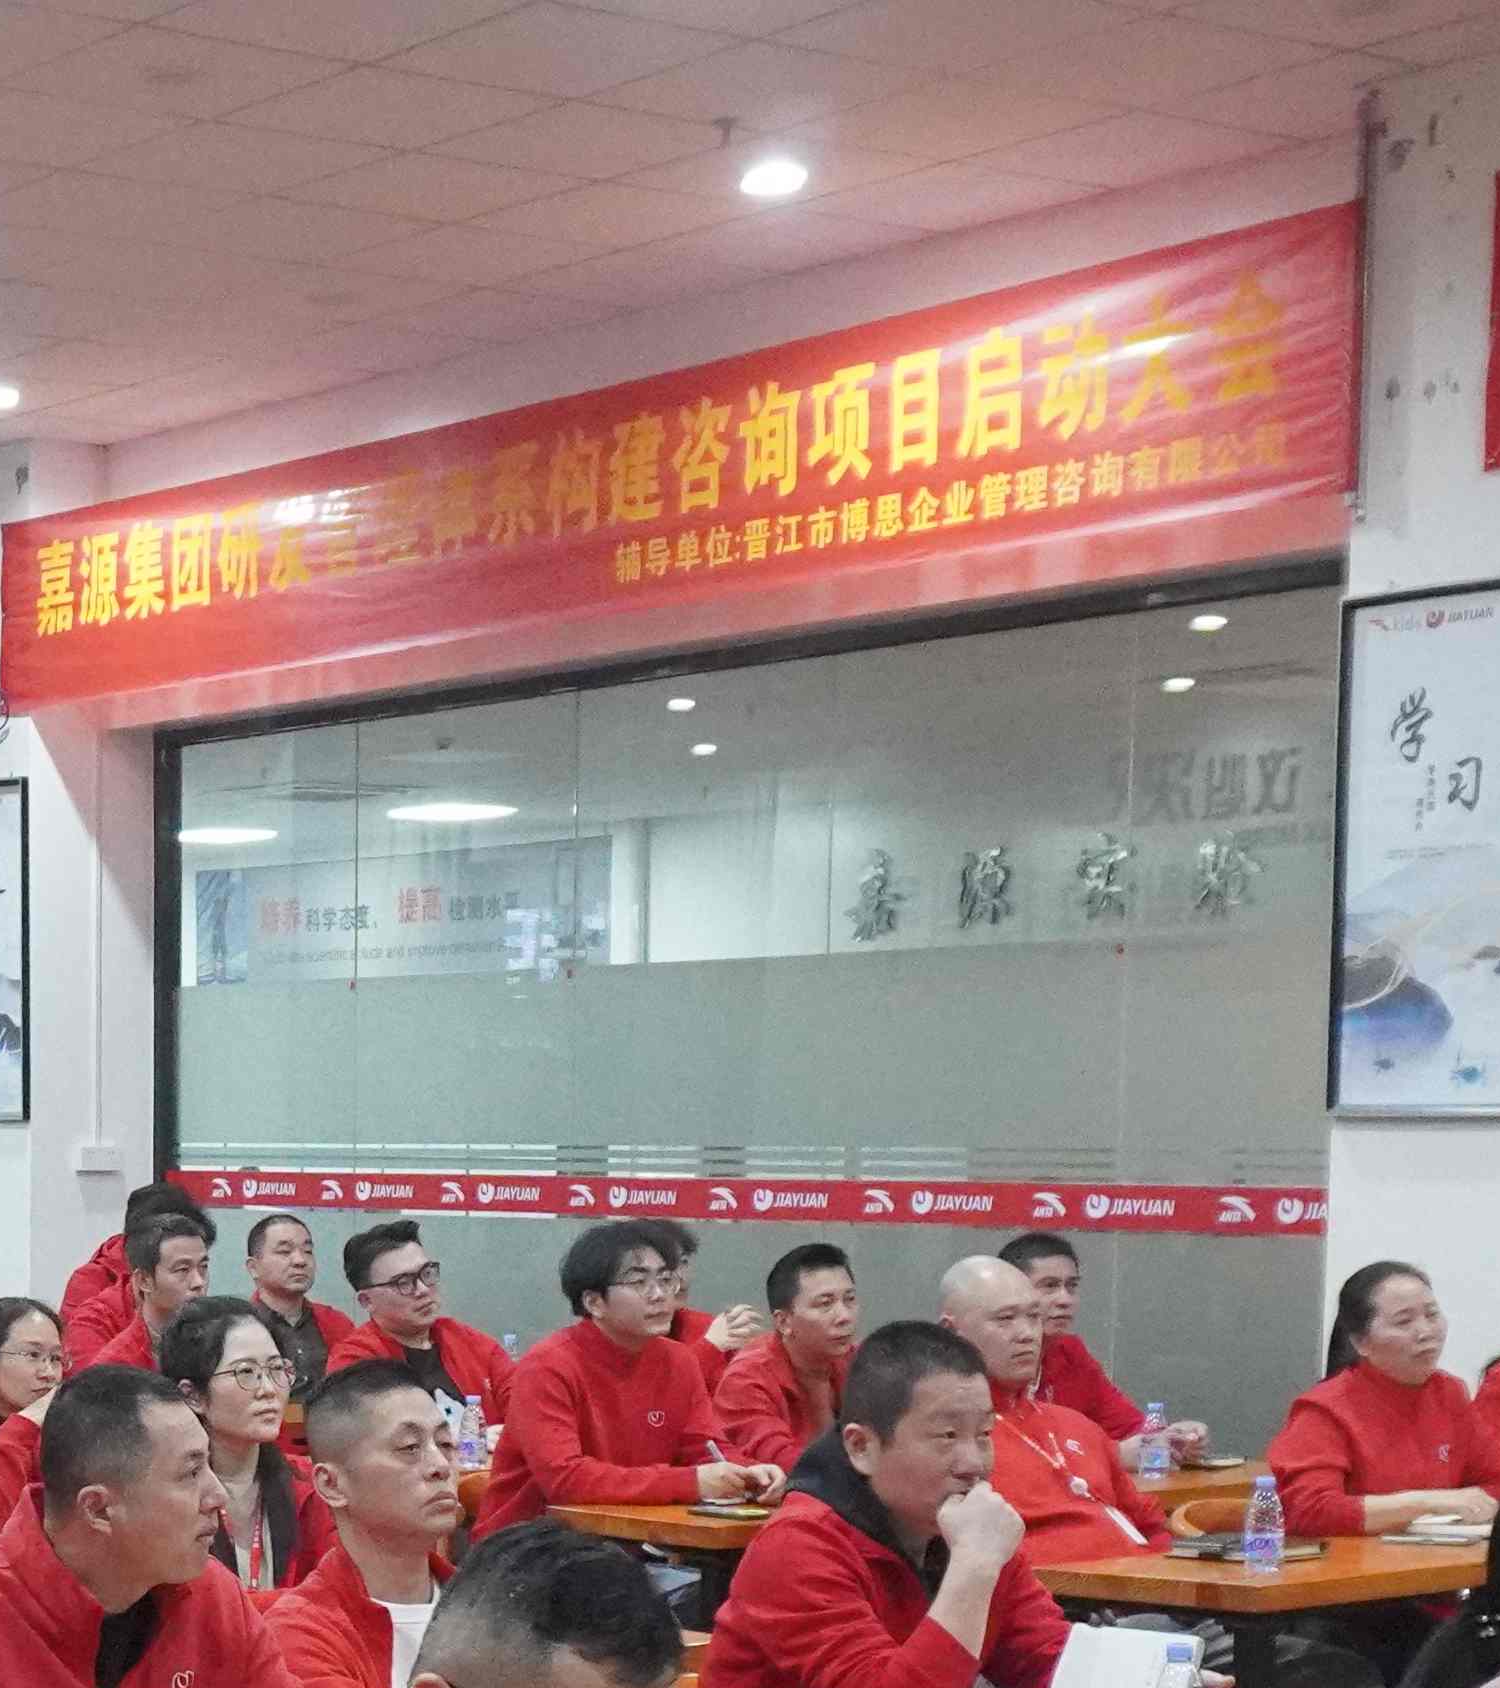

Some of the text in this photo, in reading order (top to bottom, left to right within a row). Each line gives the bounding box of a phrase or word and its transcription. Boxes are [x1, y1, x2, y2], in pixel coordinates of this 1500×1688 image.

[256, 1181, 297, 1197] JIAYUAN
[371, 1183, 414, 1199] JIAYUAN
[493, 1185, 540, 1202] JIAYUAN
[627, 1188, 677, 1207] JIAYUAN
[773, 1192, 828, 1210] JIAYUAN
[933, 1195, 994, 1213] JIAYUAN
[1109, 1197, 1175, 1217] JIAYUAN
